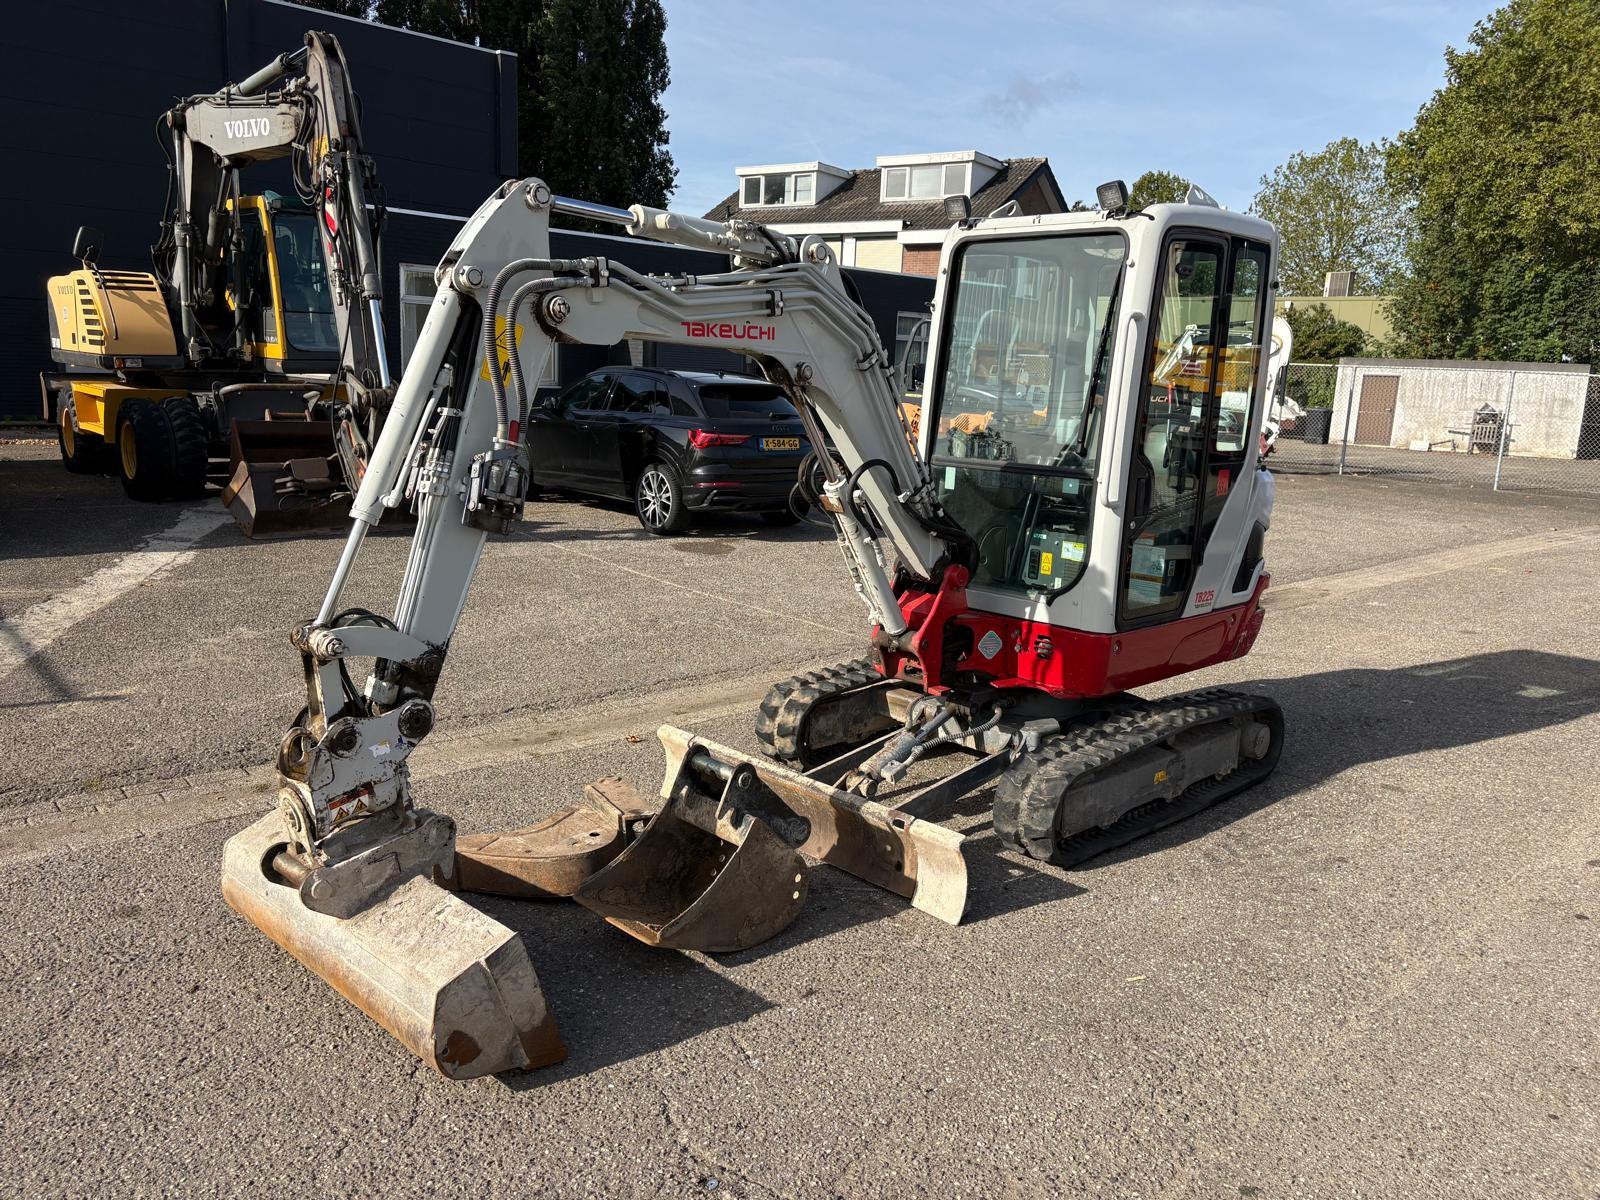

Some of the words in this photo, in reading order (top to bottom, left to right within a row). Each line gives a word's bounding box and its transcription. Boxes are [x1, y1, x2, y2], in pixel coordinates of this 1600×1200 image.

[224, 118, 270, 139] VOLVO
[681, 321, 775, 340] TAKEUCHI
[765, 439, 798, 448] X-584-GG
